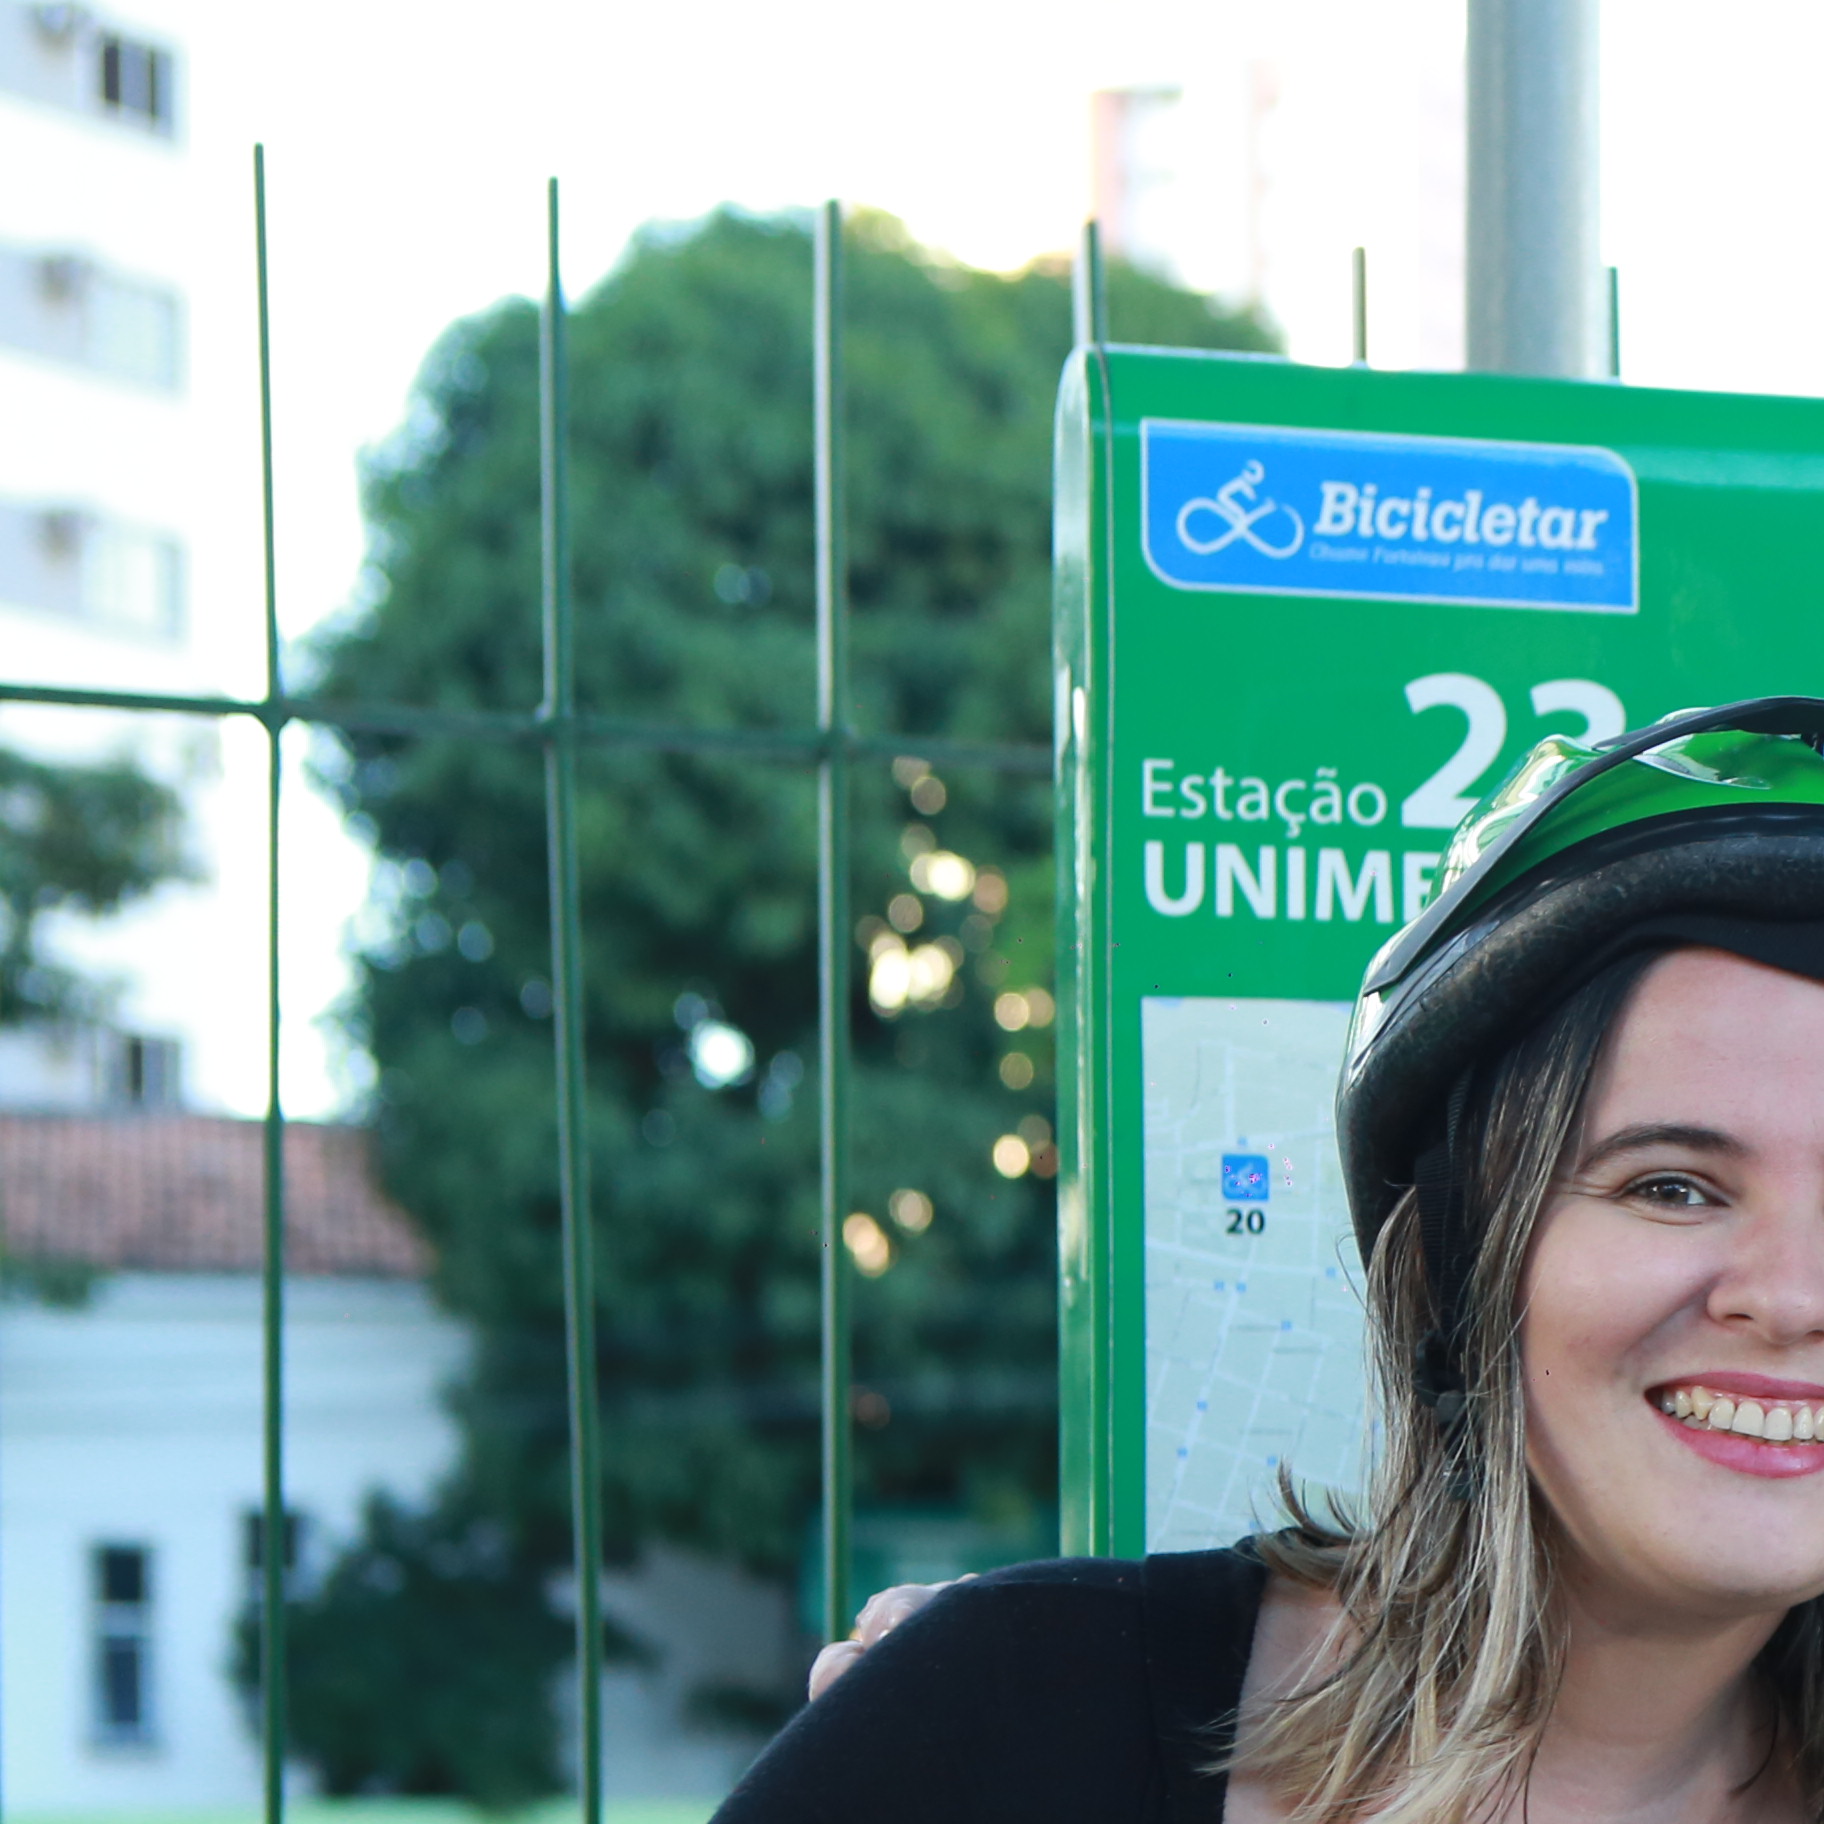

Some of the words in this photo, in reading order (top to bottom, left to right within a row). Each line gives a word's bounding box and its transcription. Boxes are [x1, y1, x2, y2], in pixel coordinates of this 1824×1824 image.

[1312, 481, 1608, 550] Bicicletar
[1142, 758, 1387, 838] Estação
[1225, 1209, 1266, 1235] 20
